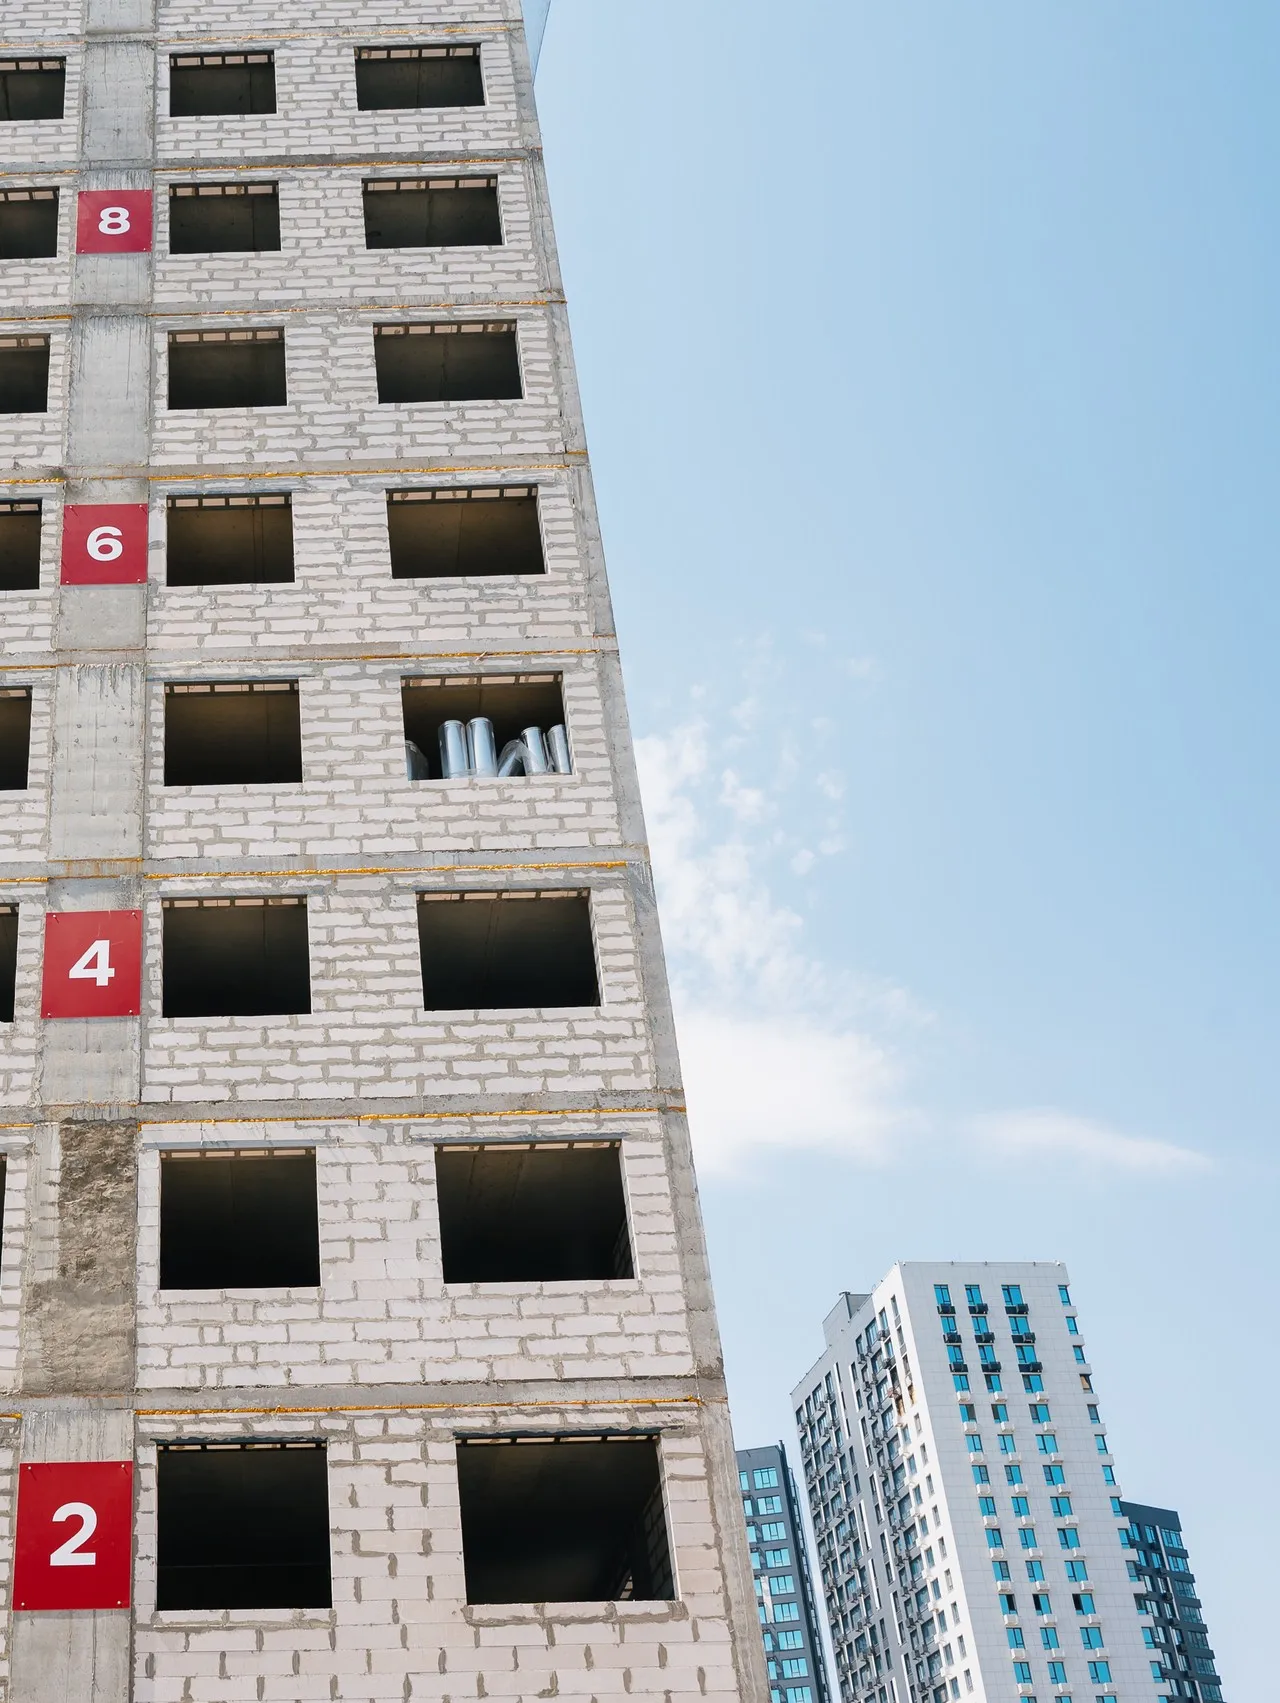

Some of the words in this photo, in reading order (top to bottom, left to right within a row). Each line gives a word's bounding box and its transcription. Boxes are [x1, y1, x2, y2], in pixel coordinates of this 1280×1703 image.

[98, 206, 130, 235] 8
[86, 525, 123, 562] 6
[68, 939, 115, 987] 4
[49, 1501, 97, 1566] 2
